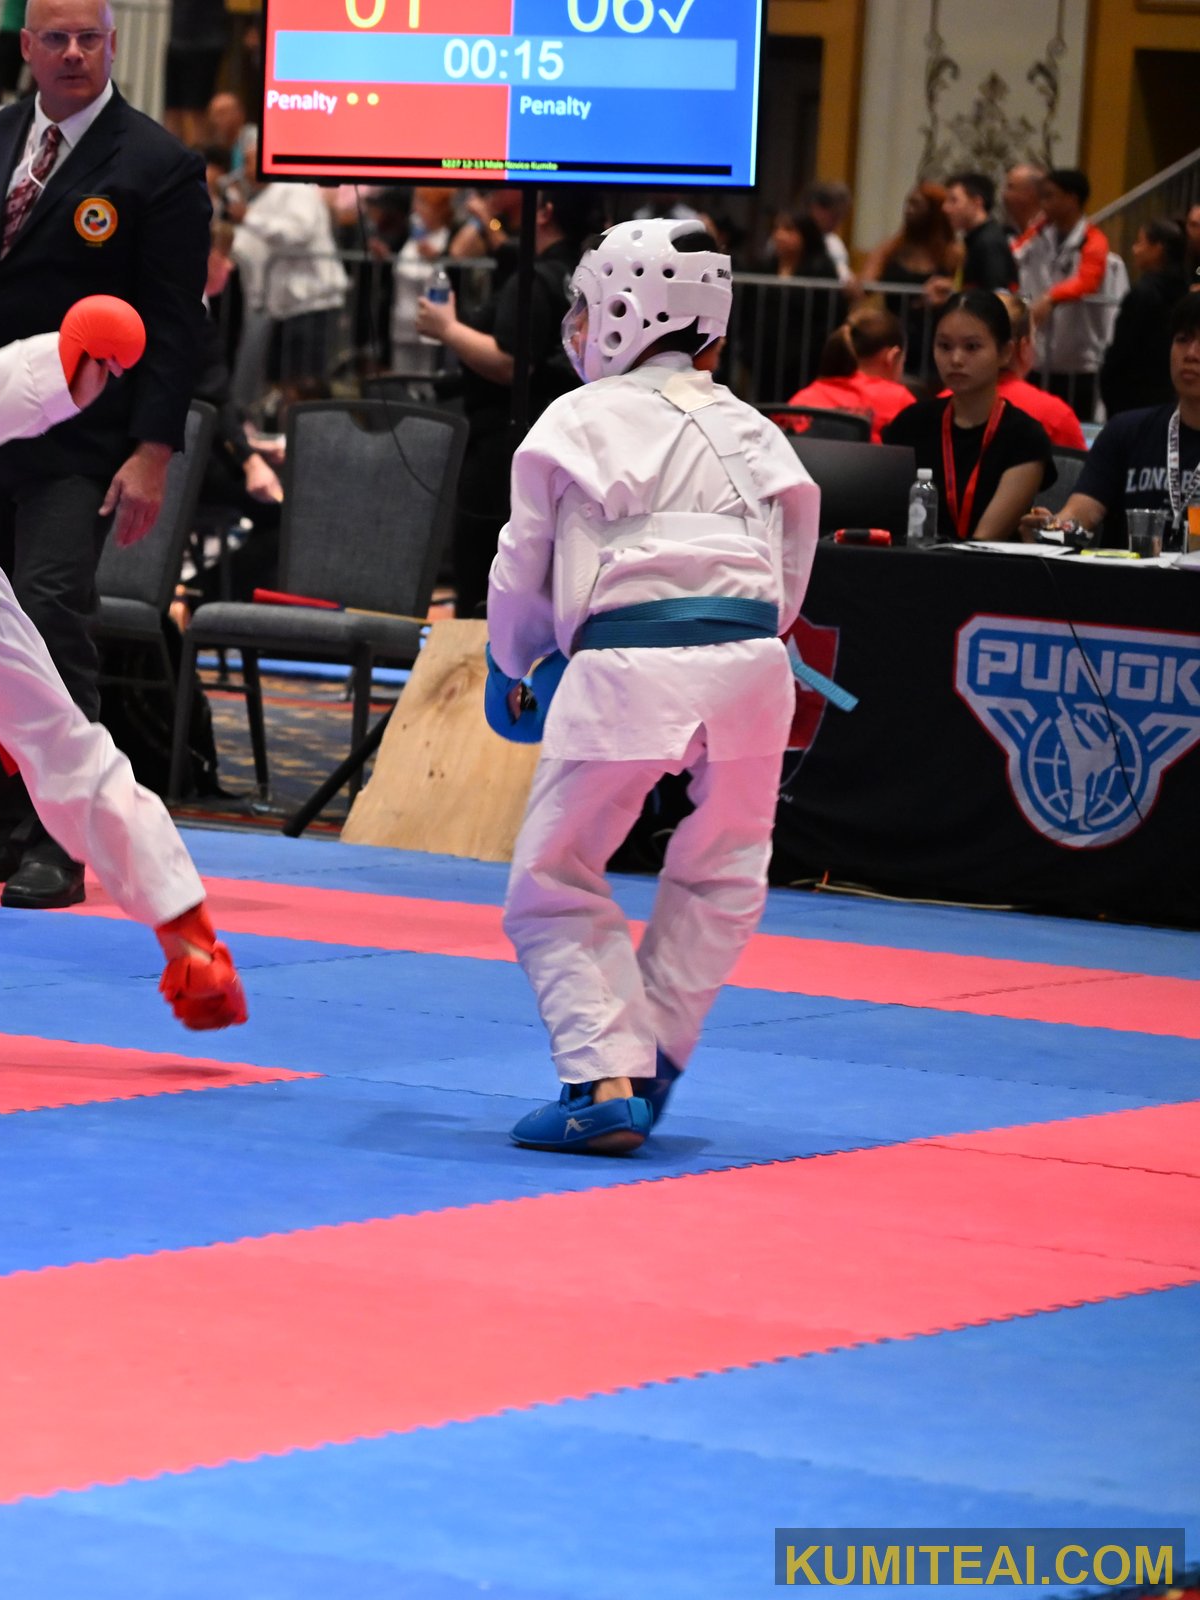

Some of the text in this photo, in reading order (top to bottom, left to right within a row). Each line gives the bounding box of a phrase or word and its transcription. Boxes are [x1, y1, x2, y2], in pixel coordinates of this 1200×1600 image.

[444, 38, 565, 81] 00:15
[267, 90, 338, 116] Penalty
[519, 95, 592, 121] Penalty
[977, 639, 1200, 707] PUNOK
